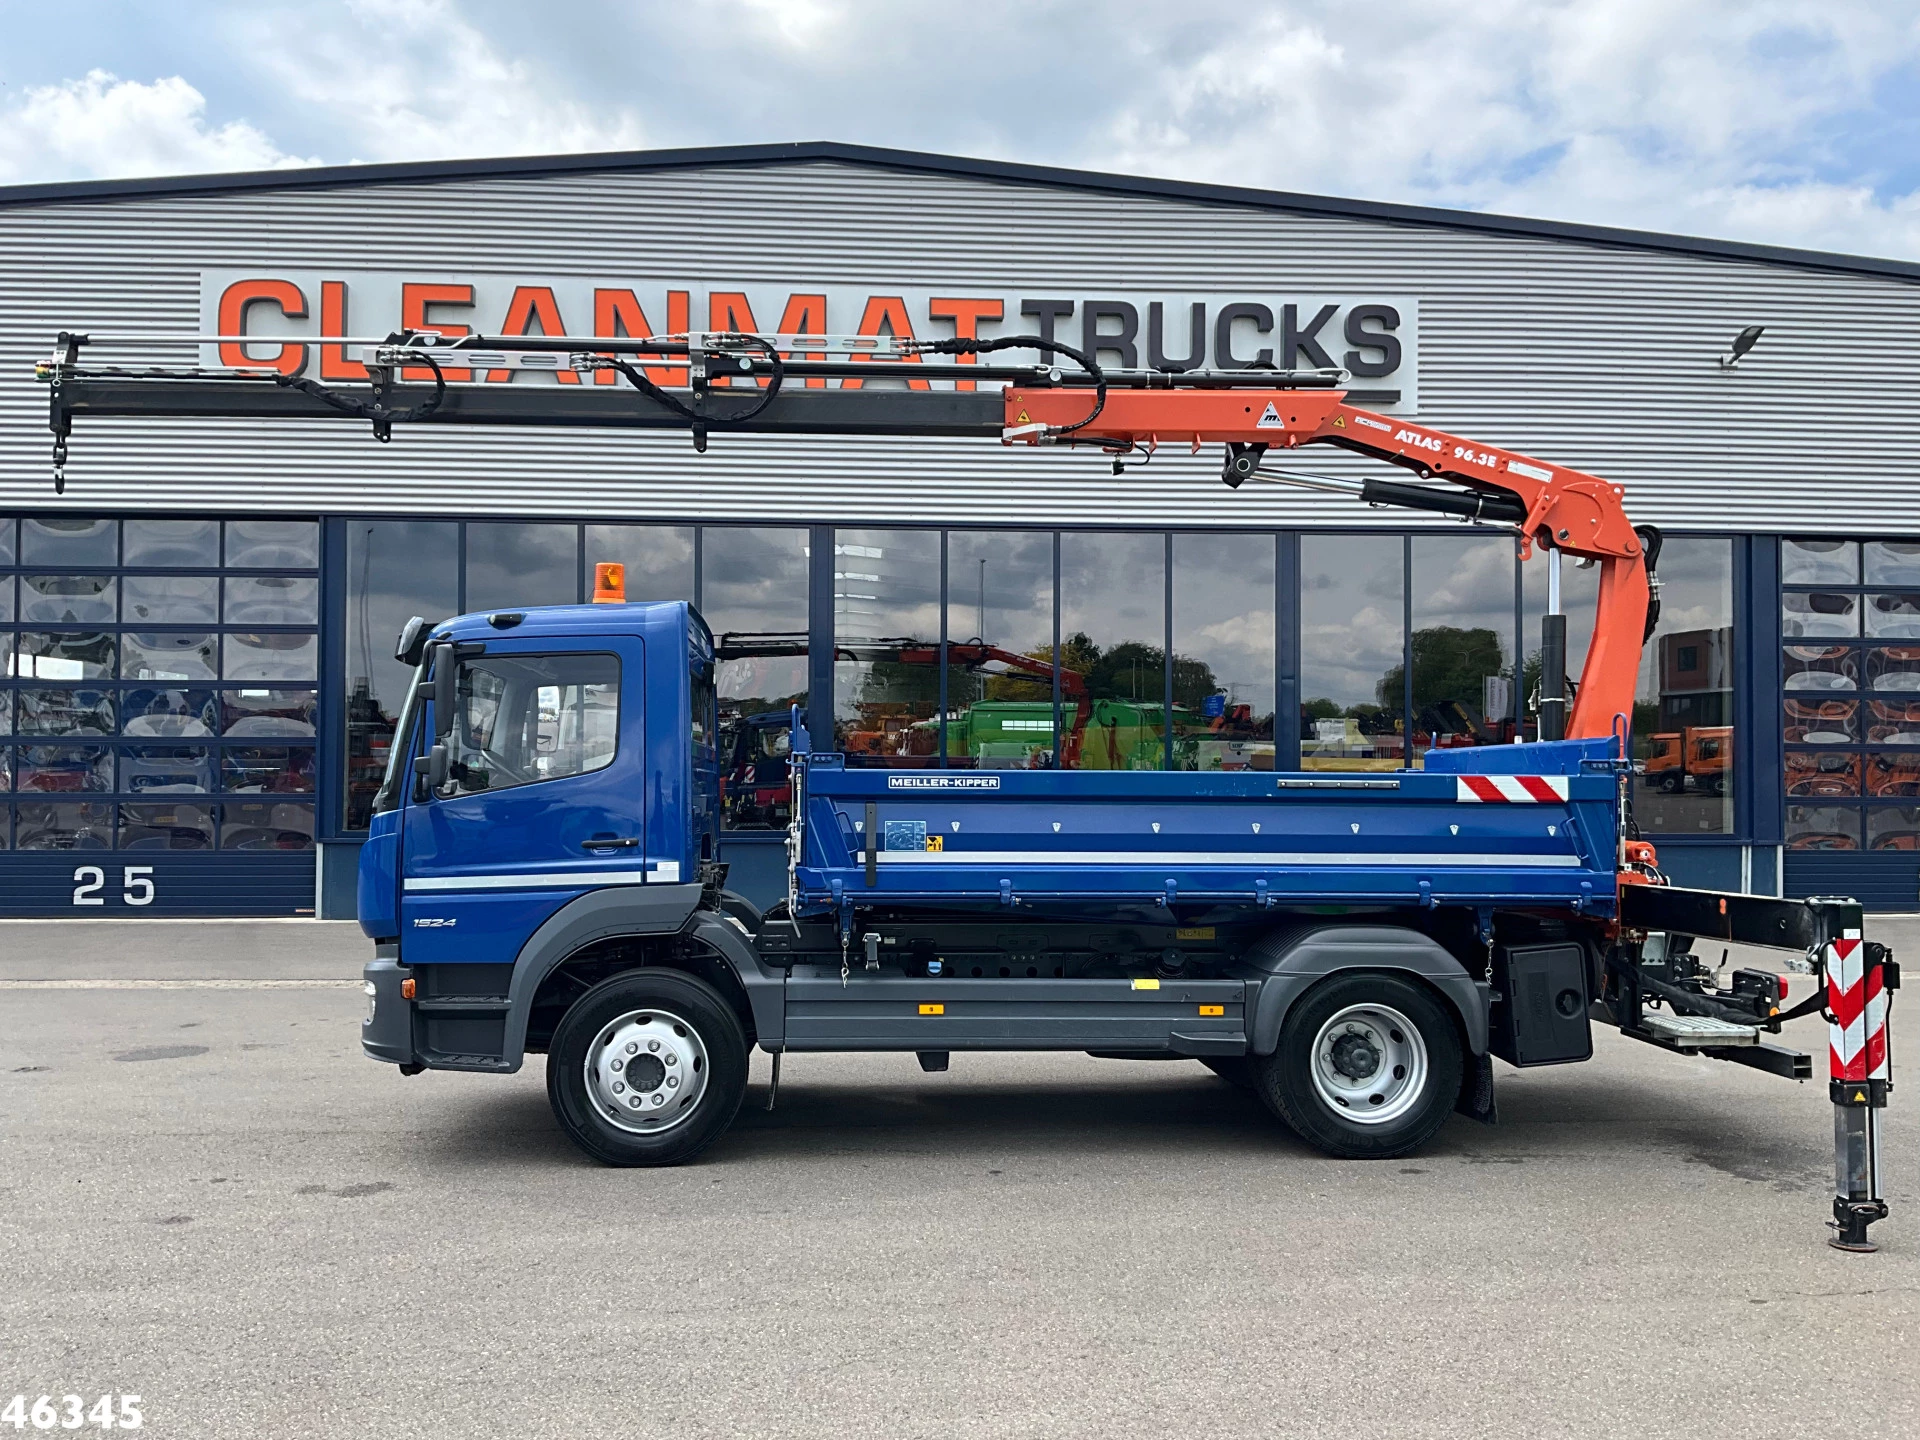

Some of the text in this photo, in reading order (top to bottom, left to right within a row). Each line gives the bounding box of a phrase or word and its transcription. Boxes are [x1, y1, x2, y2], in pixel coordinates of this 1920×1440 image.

[218, 279, 1401, 391] CLEANMAT TRUCKS
[1394, 429, 1497, 468] ATLAS 96.3E
[891, 778, 997, 787] MEILLER-KIPPER
[413, 918, 457, 928] 1524
